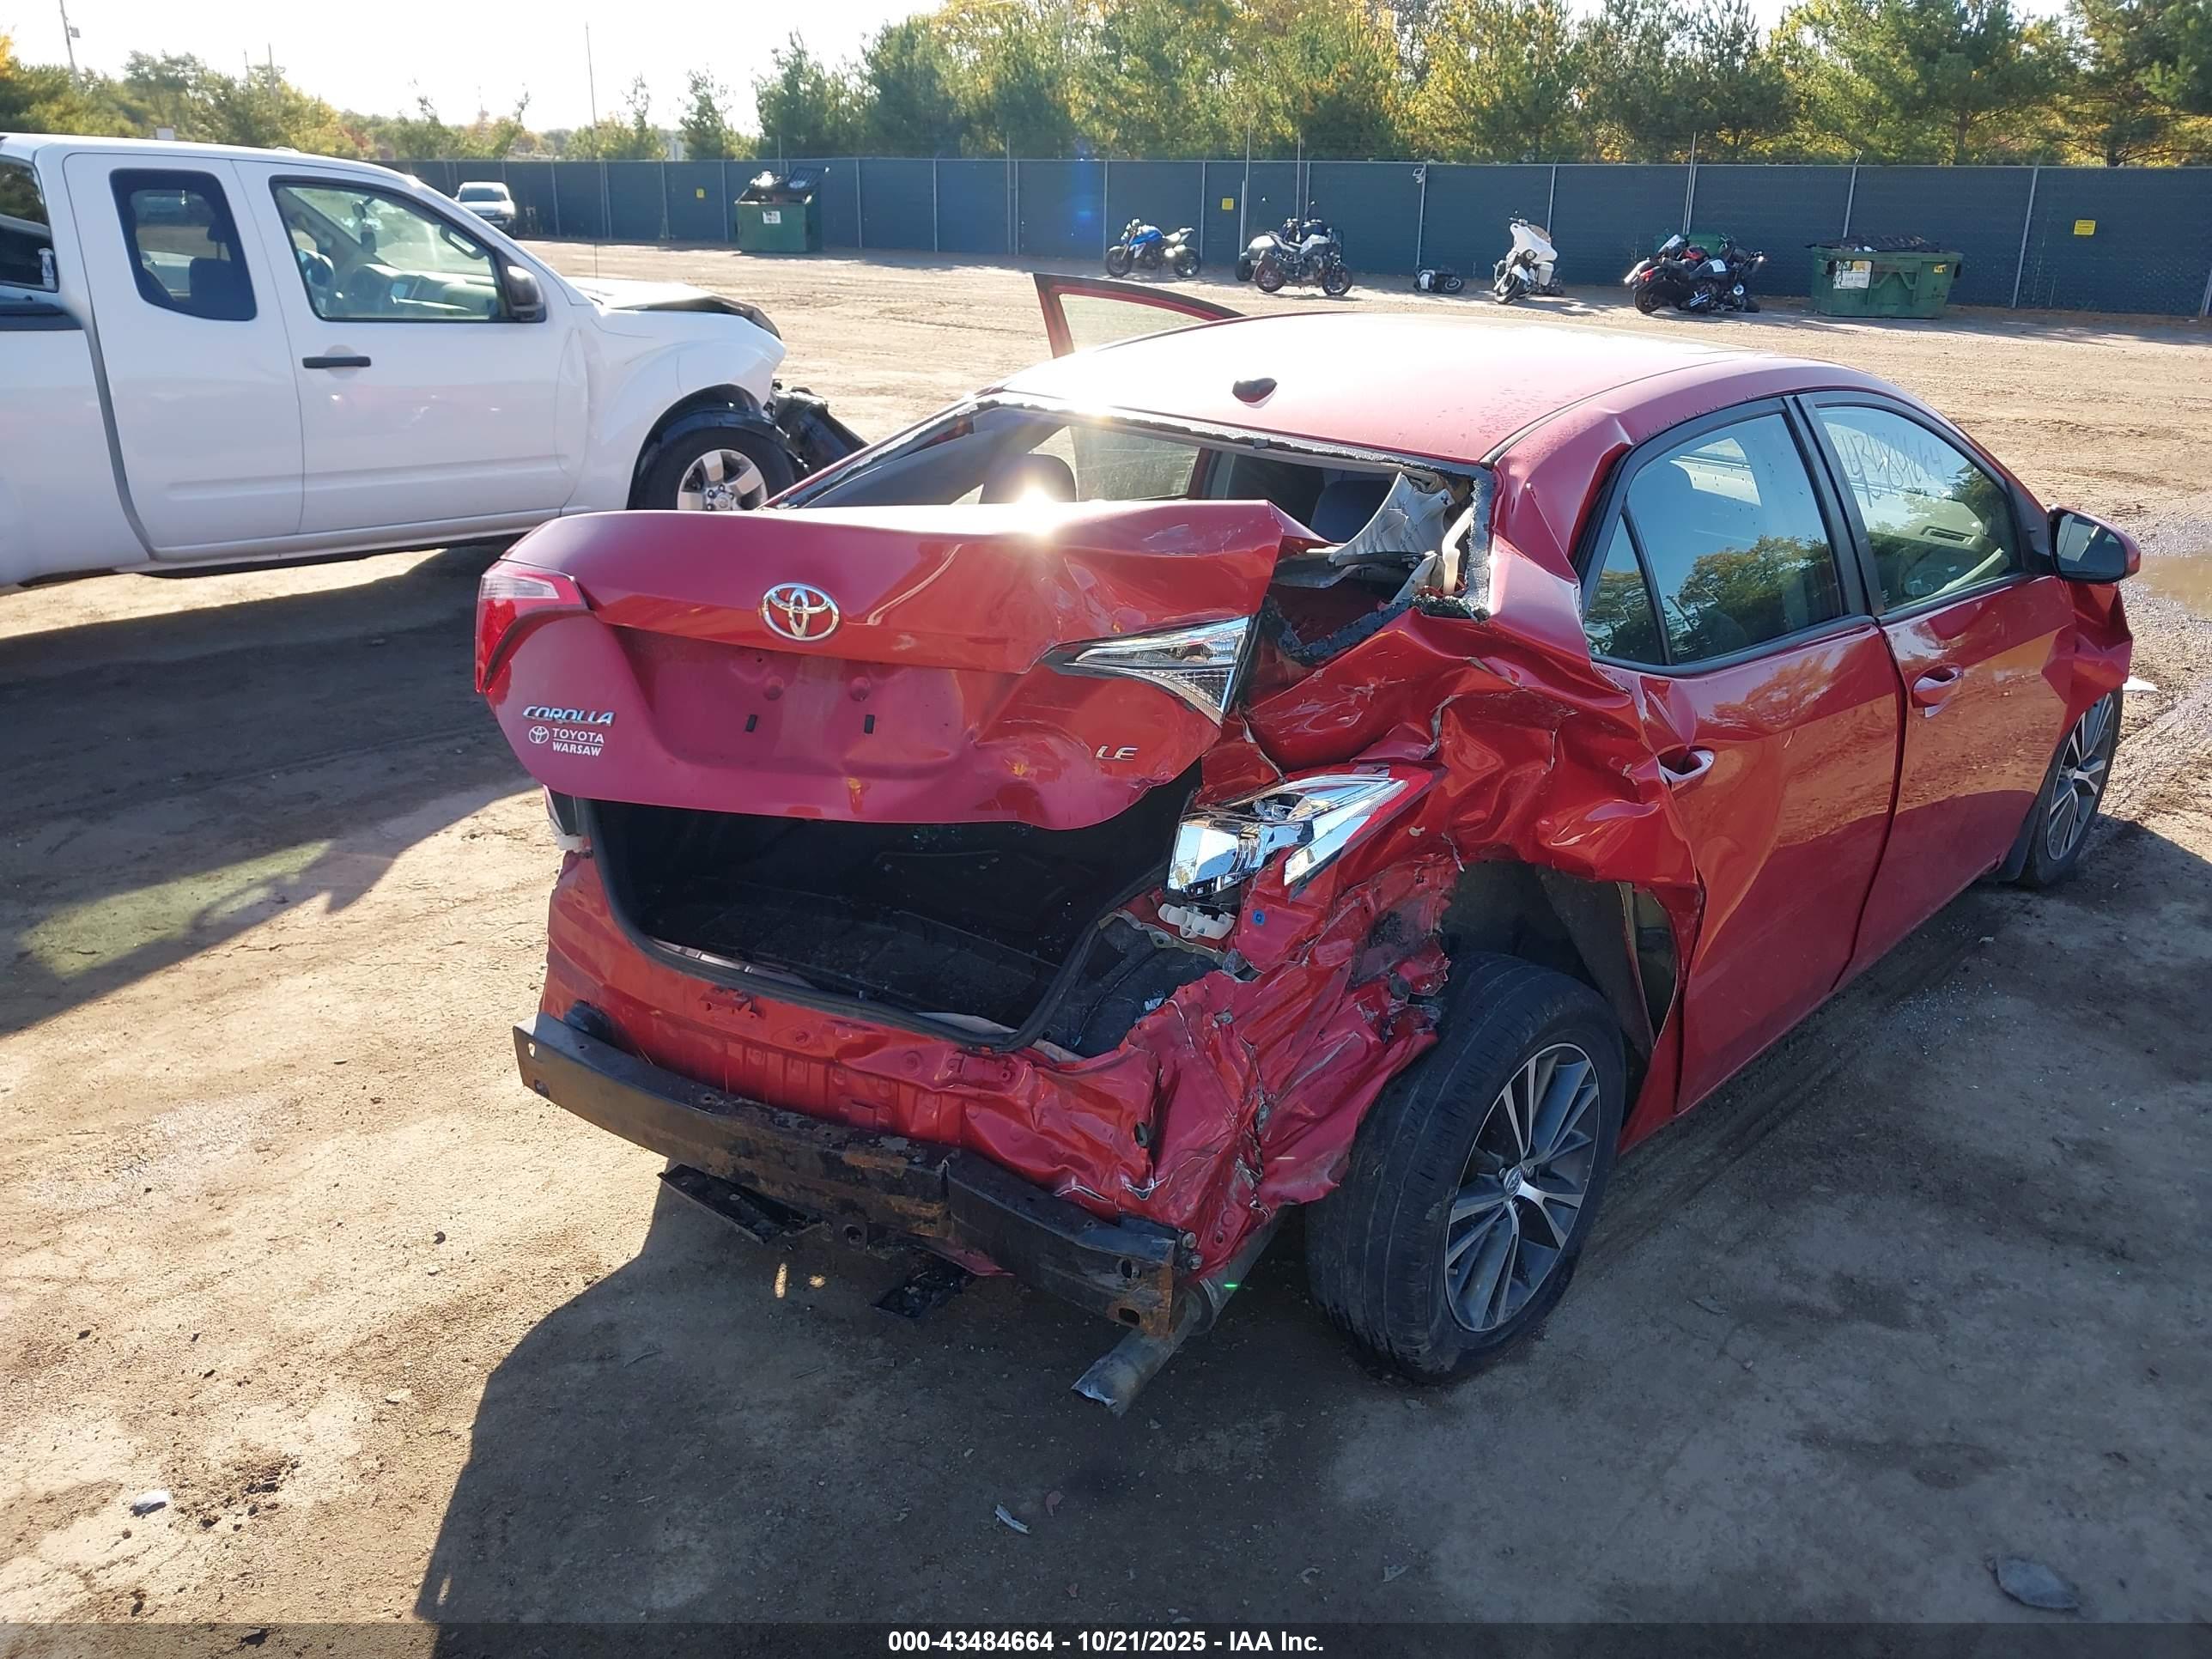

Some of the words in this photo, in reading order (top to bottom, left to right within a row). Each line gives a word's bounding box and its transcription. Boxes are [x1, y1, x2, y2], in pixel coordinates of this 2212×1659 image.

[522, 706, 616, 726] COROLLA
[552, 727, 605, 744] TOYOTA
[552, 741, 602, 757] WARSAW
[1095, 745, 1139, 761] LE
